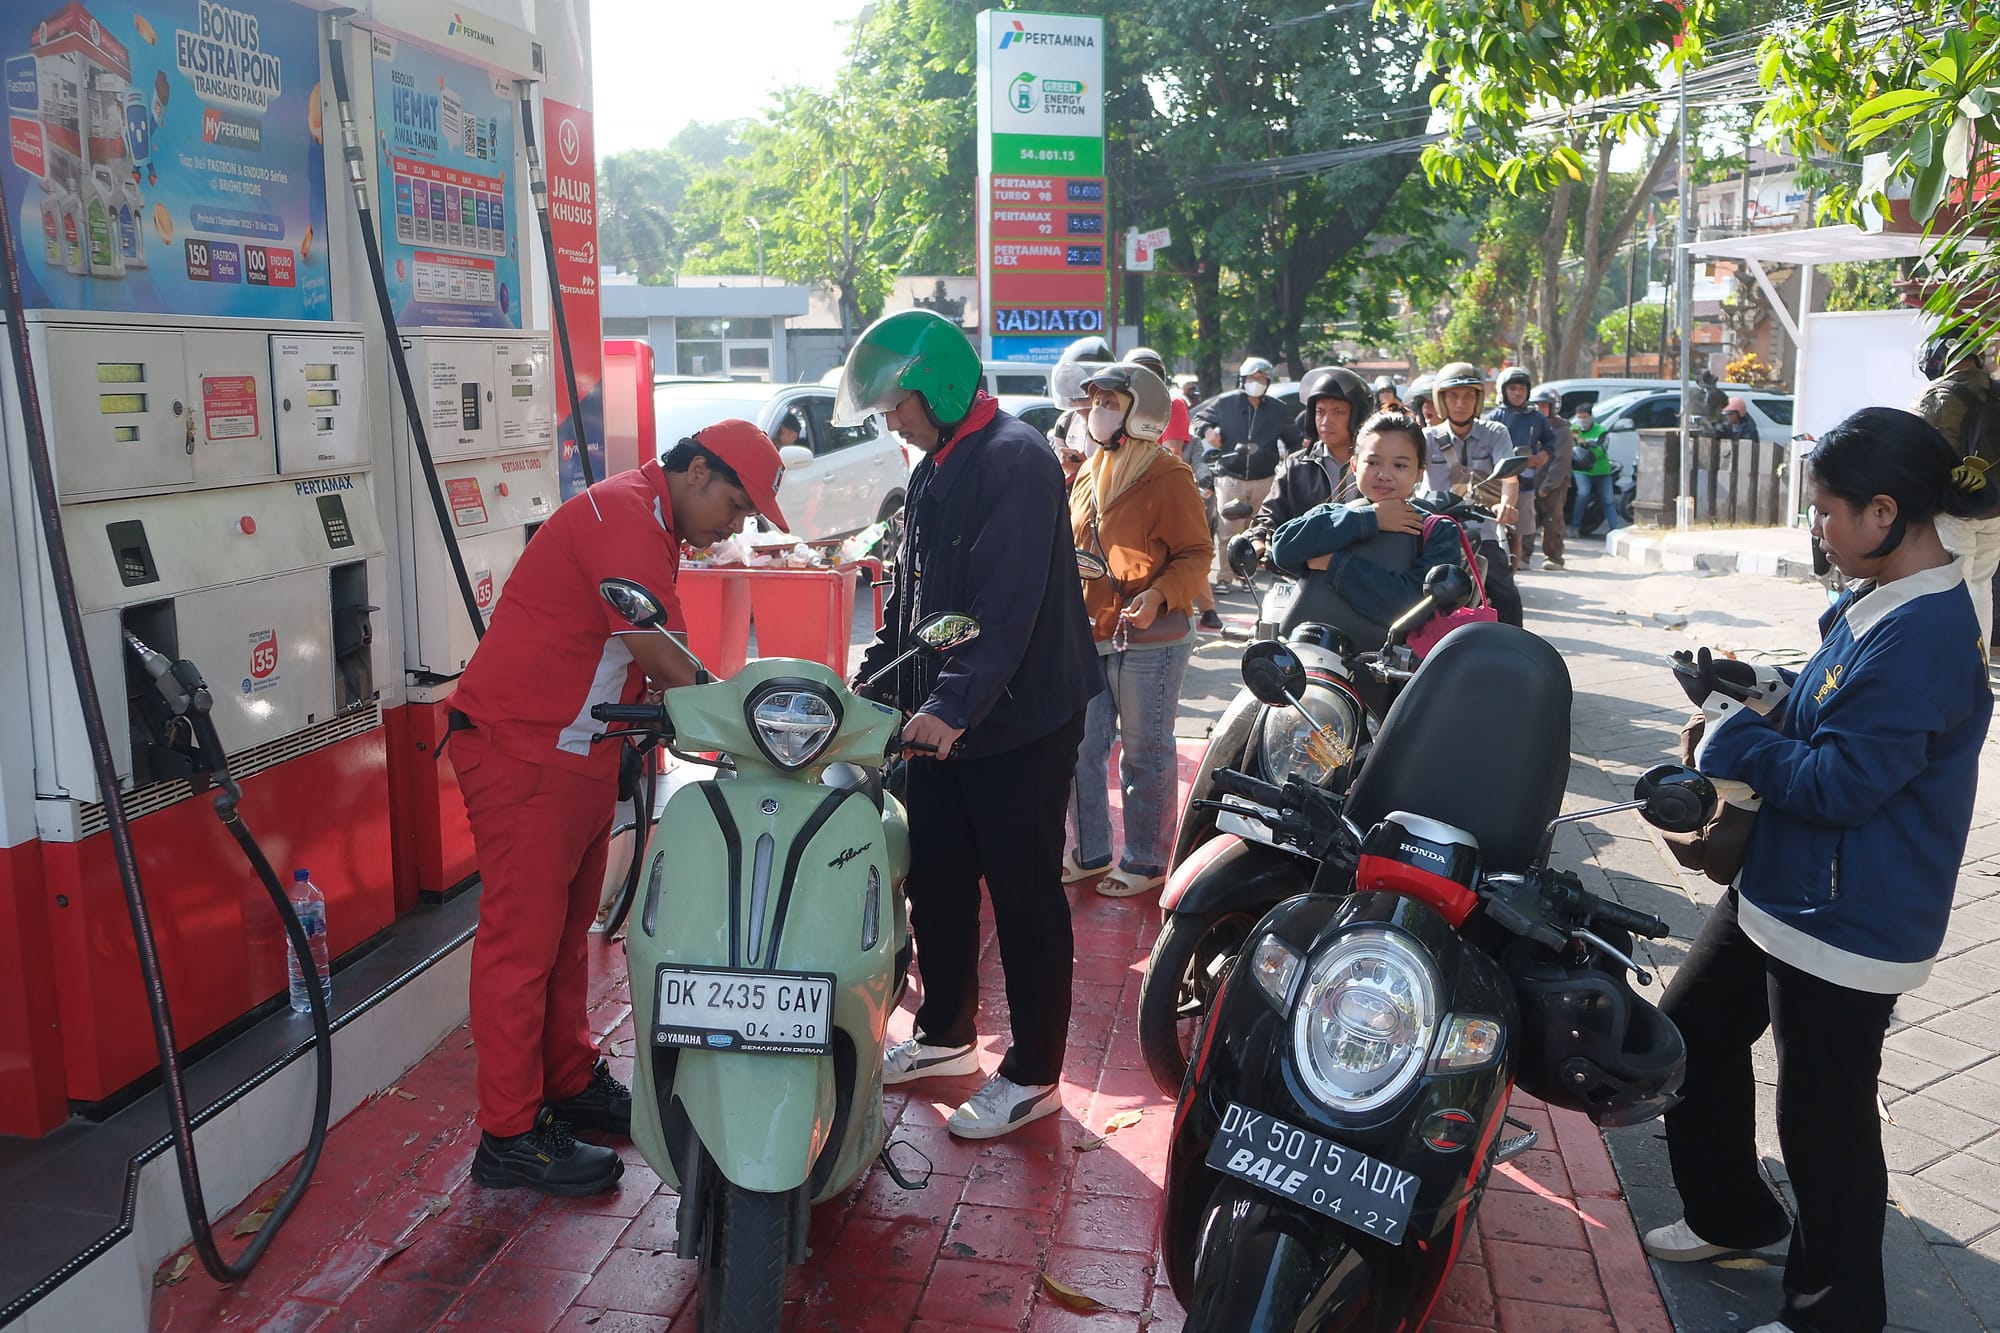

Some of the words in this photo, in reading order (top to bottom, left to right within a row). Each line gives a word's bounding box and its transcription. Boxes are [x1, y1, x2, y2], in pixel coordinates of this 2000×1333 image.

[200, 4, 258, 52] BONUS
[463, 26, 495, 46] PERTAMINA
[1025, 32, 1095, 48] PERTAMINA
[177, 33, 238, 81] EKSTRA
[241, 51, 280, 91] POIN
[195, 75, 241, 102] TRANSAKSI
[241, 86, 266, 107] PAKAI
[1044, 81, 1077, 93] GREEN
[392, 84, 439, 132] HEMAT
[1044, 94, 1081, 105] ENERGY
[1044, 104, 1085, 115] STATION
[394, 127, 414, 145] AWAL
[414, 131, 438, 151] TAHUN!
[1020, 149, 1075, 161] 54.801.15
[207, 158, 237, 175] FASTRON
[243, 165, 270, 181] ENDURO
[270, 169, 288, 184] Series
[218, 178, 242, 194] BRIGHT
[242, 182, 261, 196] STORE
[552, 175, 591, 205] JALUR
[994, 178, 1051, 190] PERTAMAX
[994, 191, 1031, 201] TURBO
[1038, 191, 1052, 202] 98
[552, 202, 592, 225] KHUSUS
[994, 211, 1051, 222] PERTAMAX
[1038, 224, 1052, 234] 92
[189, 243, 207, 266] 150
[212, 249, 238, 262] FASTRON
[558, 247, 588, 258] PERTAMAX
[994, 245, 1061, 256] PERTAMINA
[247, 250, 266, 271] 100
[270, 255, 292, 268] ENDURO
[569, 256, 588, 264] TURBO
[994, 255, 1018, 265] DEX
[218, 263, 235, 276] Series
[274, 269, 290, 280] Series
[560, 284, 595, 296] PERTAMAX
[996, 310, 1102, 331] RADIATO
[295, 475, 354, 496] PERTAMAX
[476, 583, 491, 604] 135
[1278, 585, 1292, 596] DK
[251, 647, 275, 673] 135
[1400, 843, 1446, 864] HONDA
[667, 980, 697, 1006] DK
[707, 981, 766, 1010] 2435
[777, 986, 822, 1013] GAV
[666, 1032, 701, 1045] YAMAHA
[740, 1044, 782, 1052] SEMAKIN
[1220, 1103, 1262, 1142] DK
[1267, 1121, 1346, 1175] 5015
[1350, 1156, 1414, 1205] ADK
